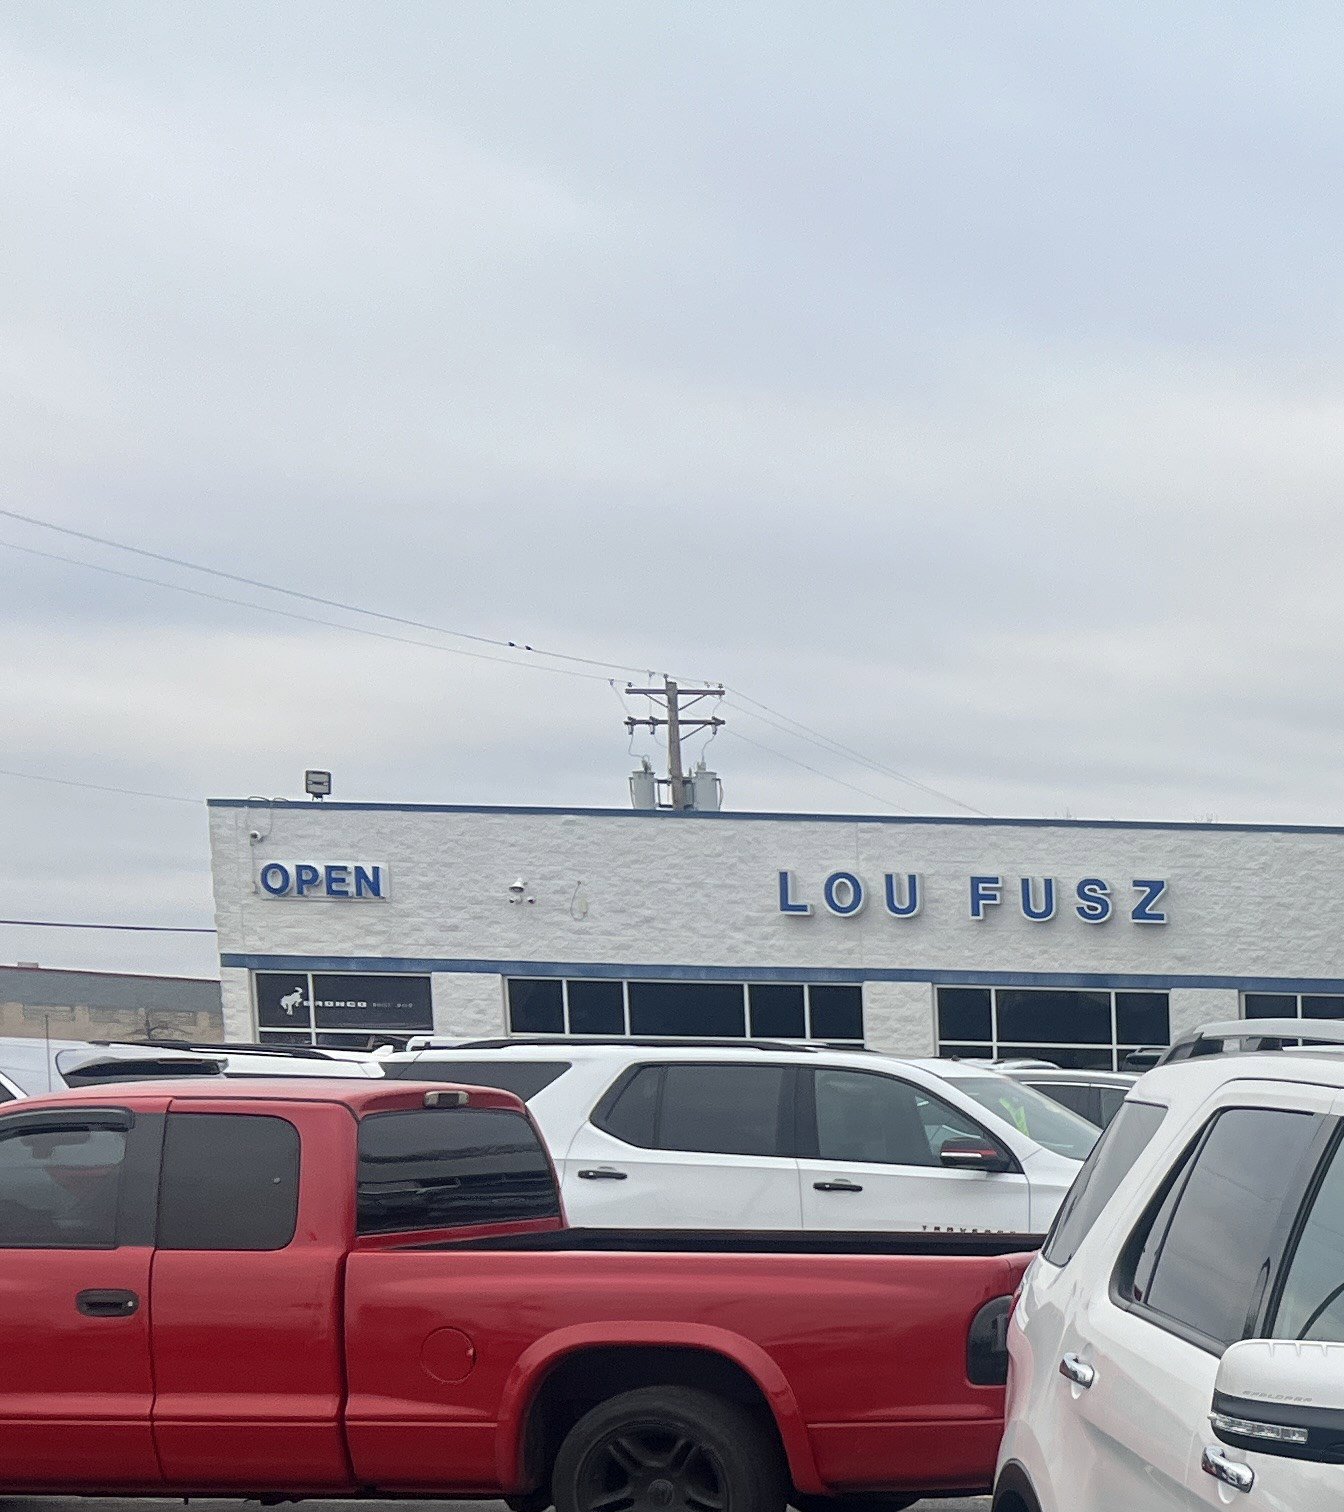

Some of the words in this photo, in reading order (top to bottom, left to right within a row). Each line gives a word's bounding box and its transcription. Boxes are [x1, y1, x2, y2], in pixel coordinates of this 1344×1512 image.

[261, 862, 384, 898] OPEN
[779, 872, 920, 917] LOU
[970, 876, 1166, 922] FUSZ
